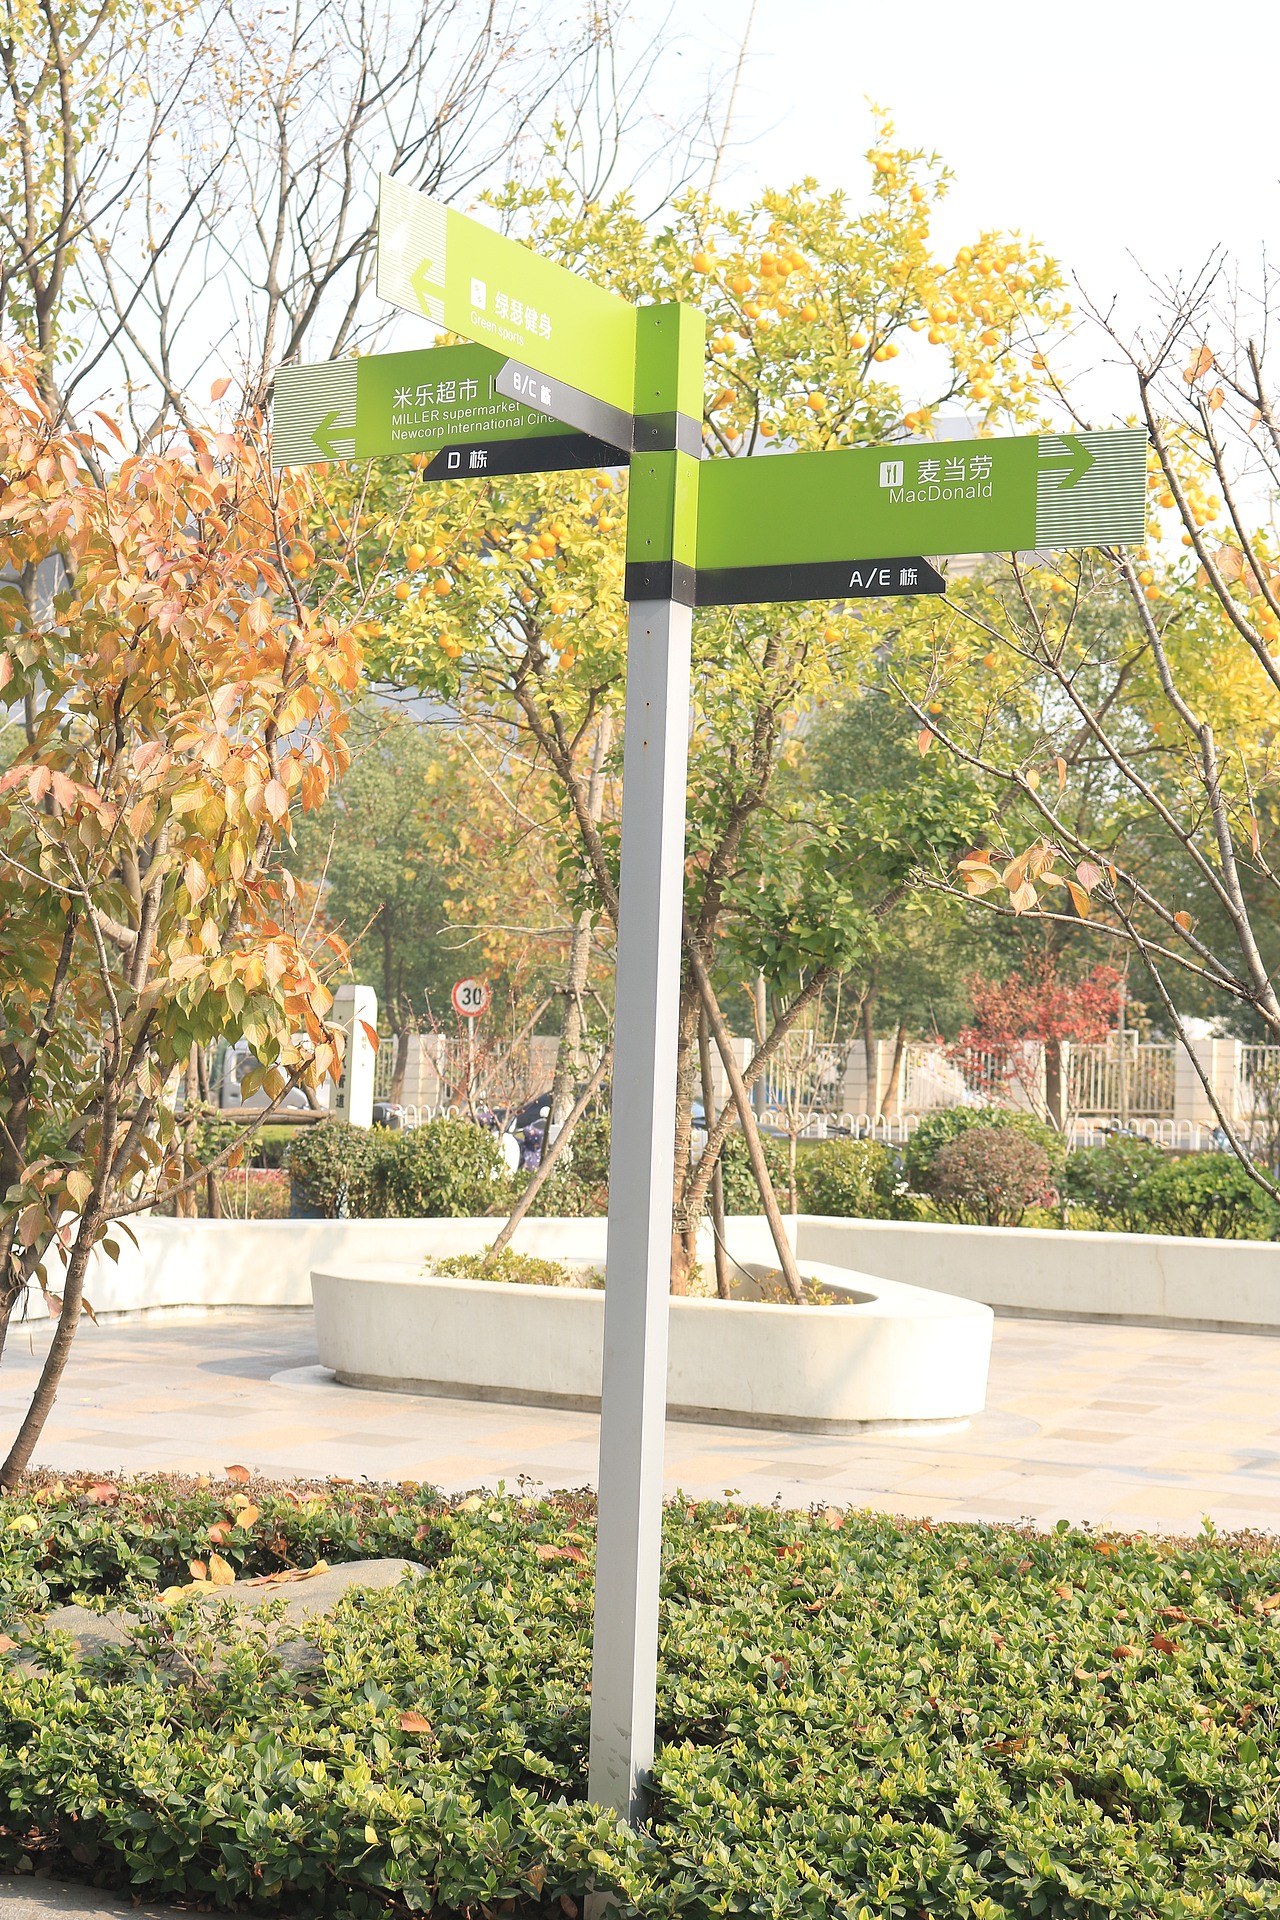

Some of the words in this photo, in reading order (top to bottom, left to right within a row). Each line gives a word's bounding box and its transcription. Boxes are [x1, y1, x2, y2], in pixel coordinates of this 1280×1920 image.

[470, 310, 497, 333] Green
[498, 326, 524, 346] sports
[495, 290, 552, 340] 绿瑟健身
[392, 378, 479, 409] 米乐超市
[513, 371, 537, 398] B/C
[540, 384, 552, 406] 栋
[391, 424, 444, 441] Newcorp
[447, 415, 524, 434] International
[527, 413, 559, 424] Cine
[392, 409, 440, 426] MILLER
[442, 401, 521, 421] supermarket
[447, 452, 461, 469] D
[468, 450, 488, 469] 栋
[917, 455, 993, 484] 麦当劳
[888, 482, 993, 504] MacDonald
[849, 568, 891, 588] A/E
[899, 567, 918, 587] 栋
[462, 987, 482, 1005] 30
